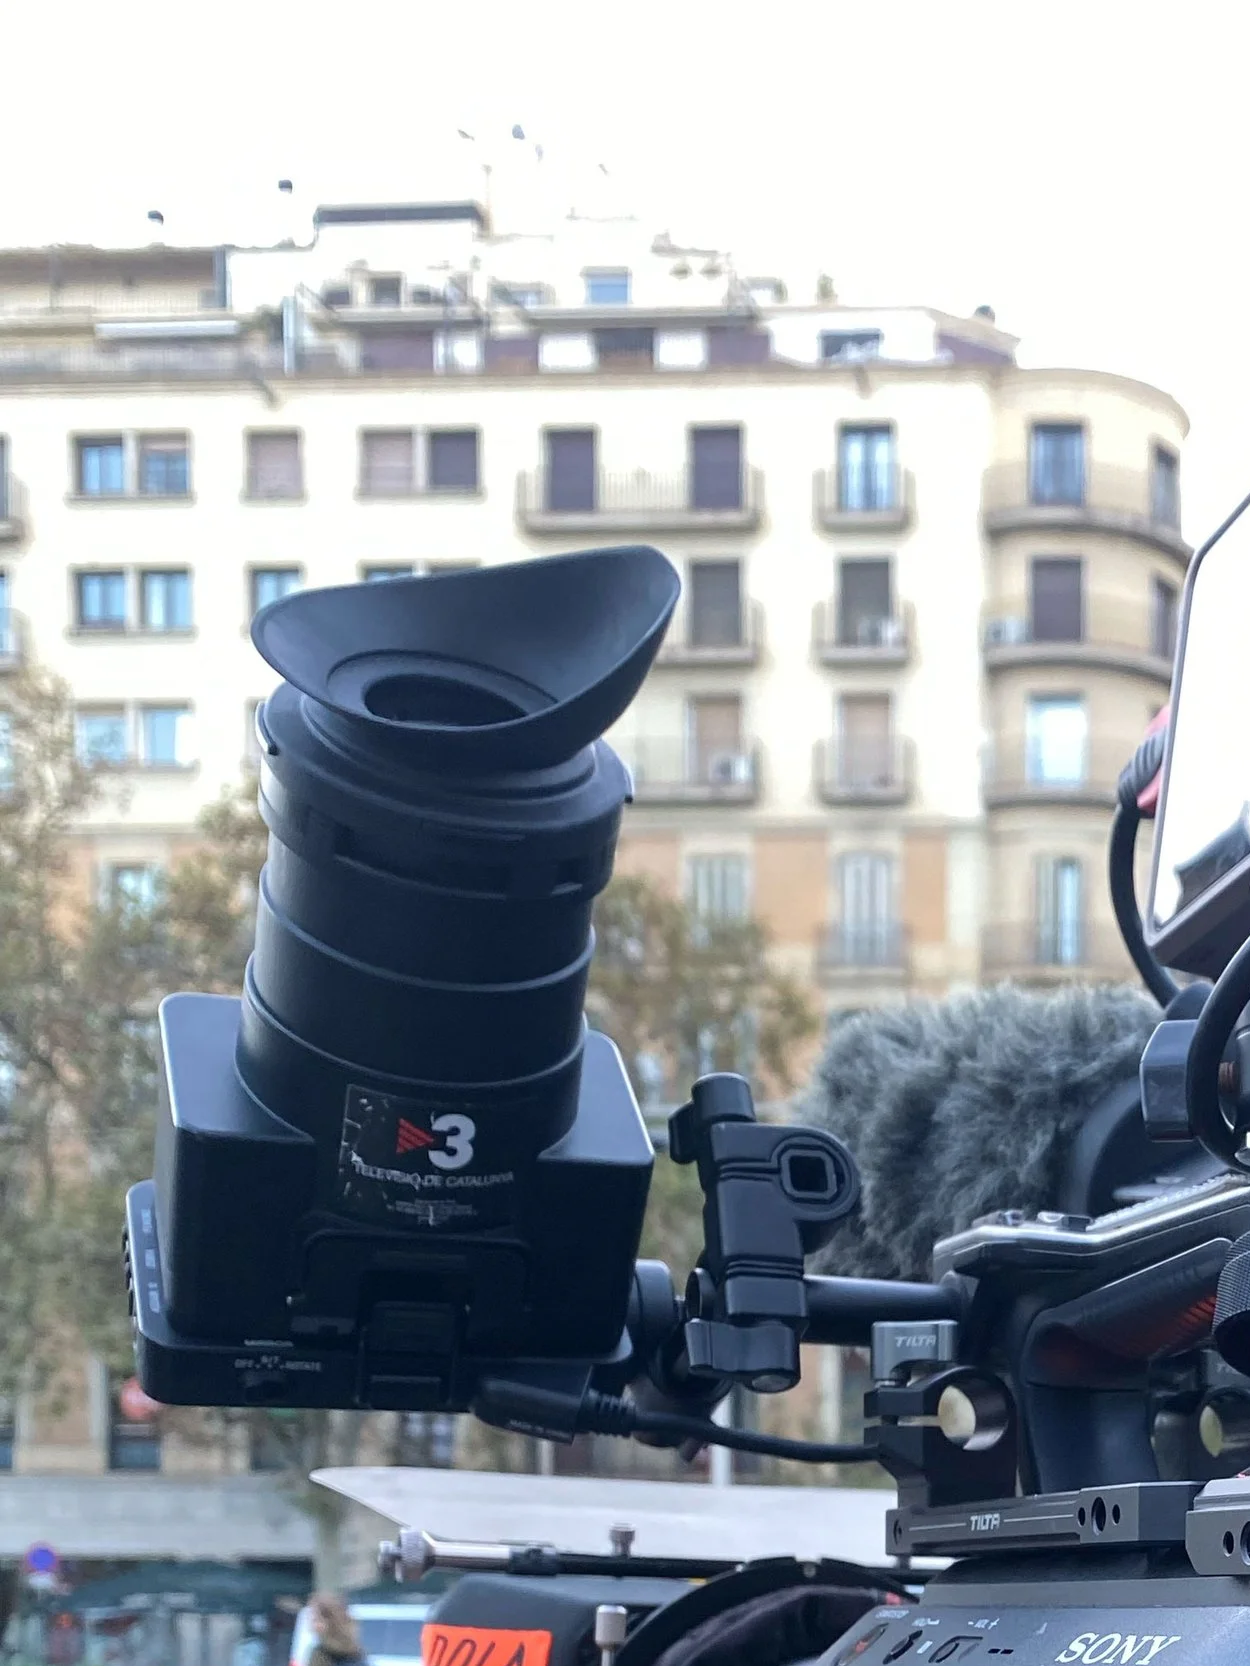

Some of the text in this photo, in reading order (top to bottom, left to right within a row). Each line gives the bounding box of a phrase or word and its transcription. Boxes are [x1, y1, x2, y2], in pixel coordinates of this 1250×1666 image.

[428, 1113, 476, 1170] 3
[895, 1334, 937, 1348] TILTA
[969, 1512, 1001, 1532] TILTA
[1055, 1632, 1181, 1665] SONY
